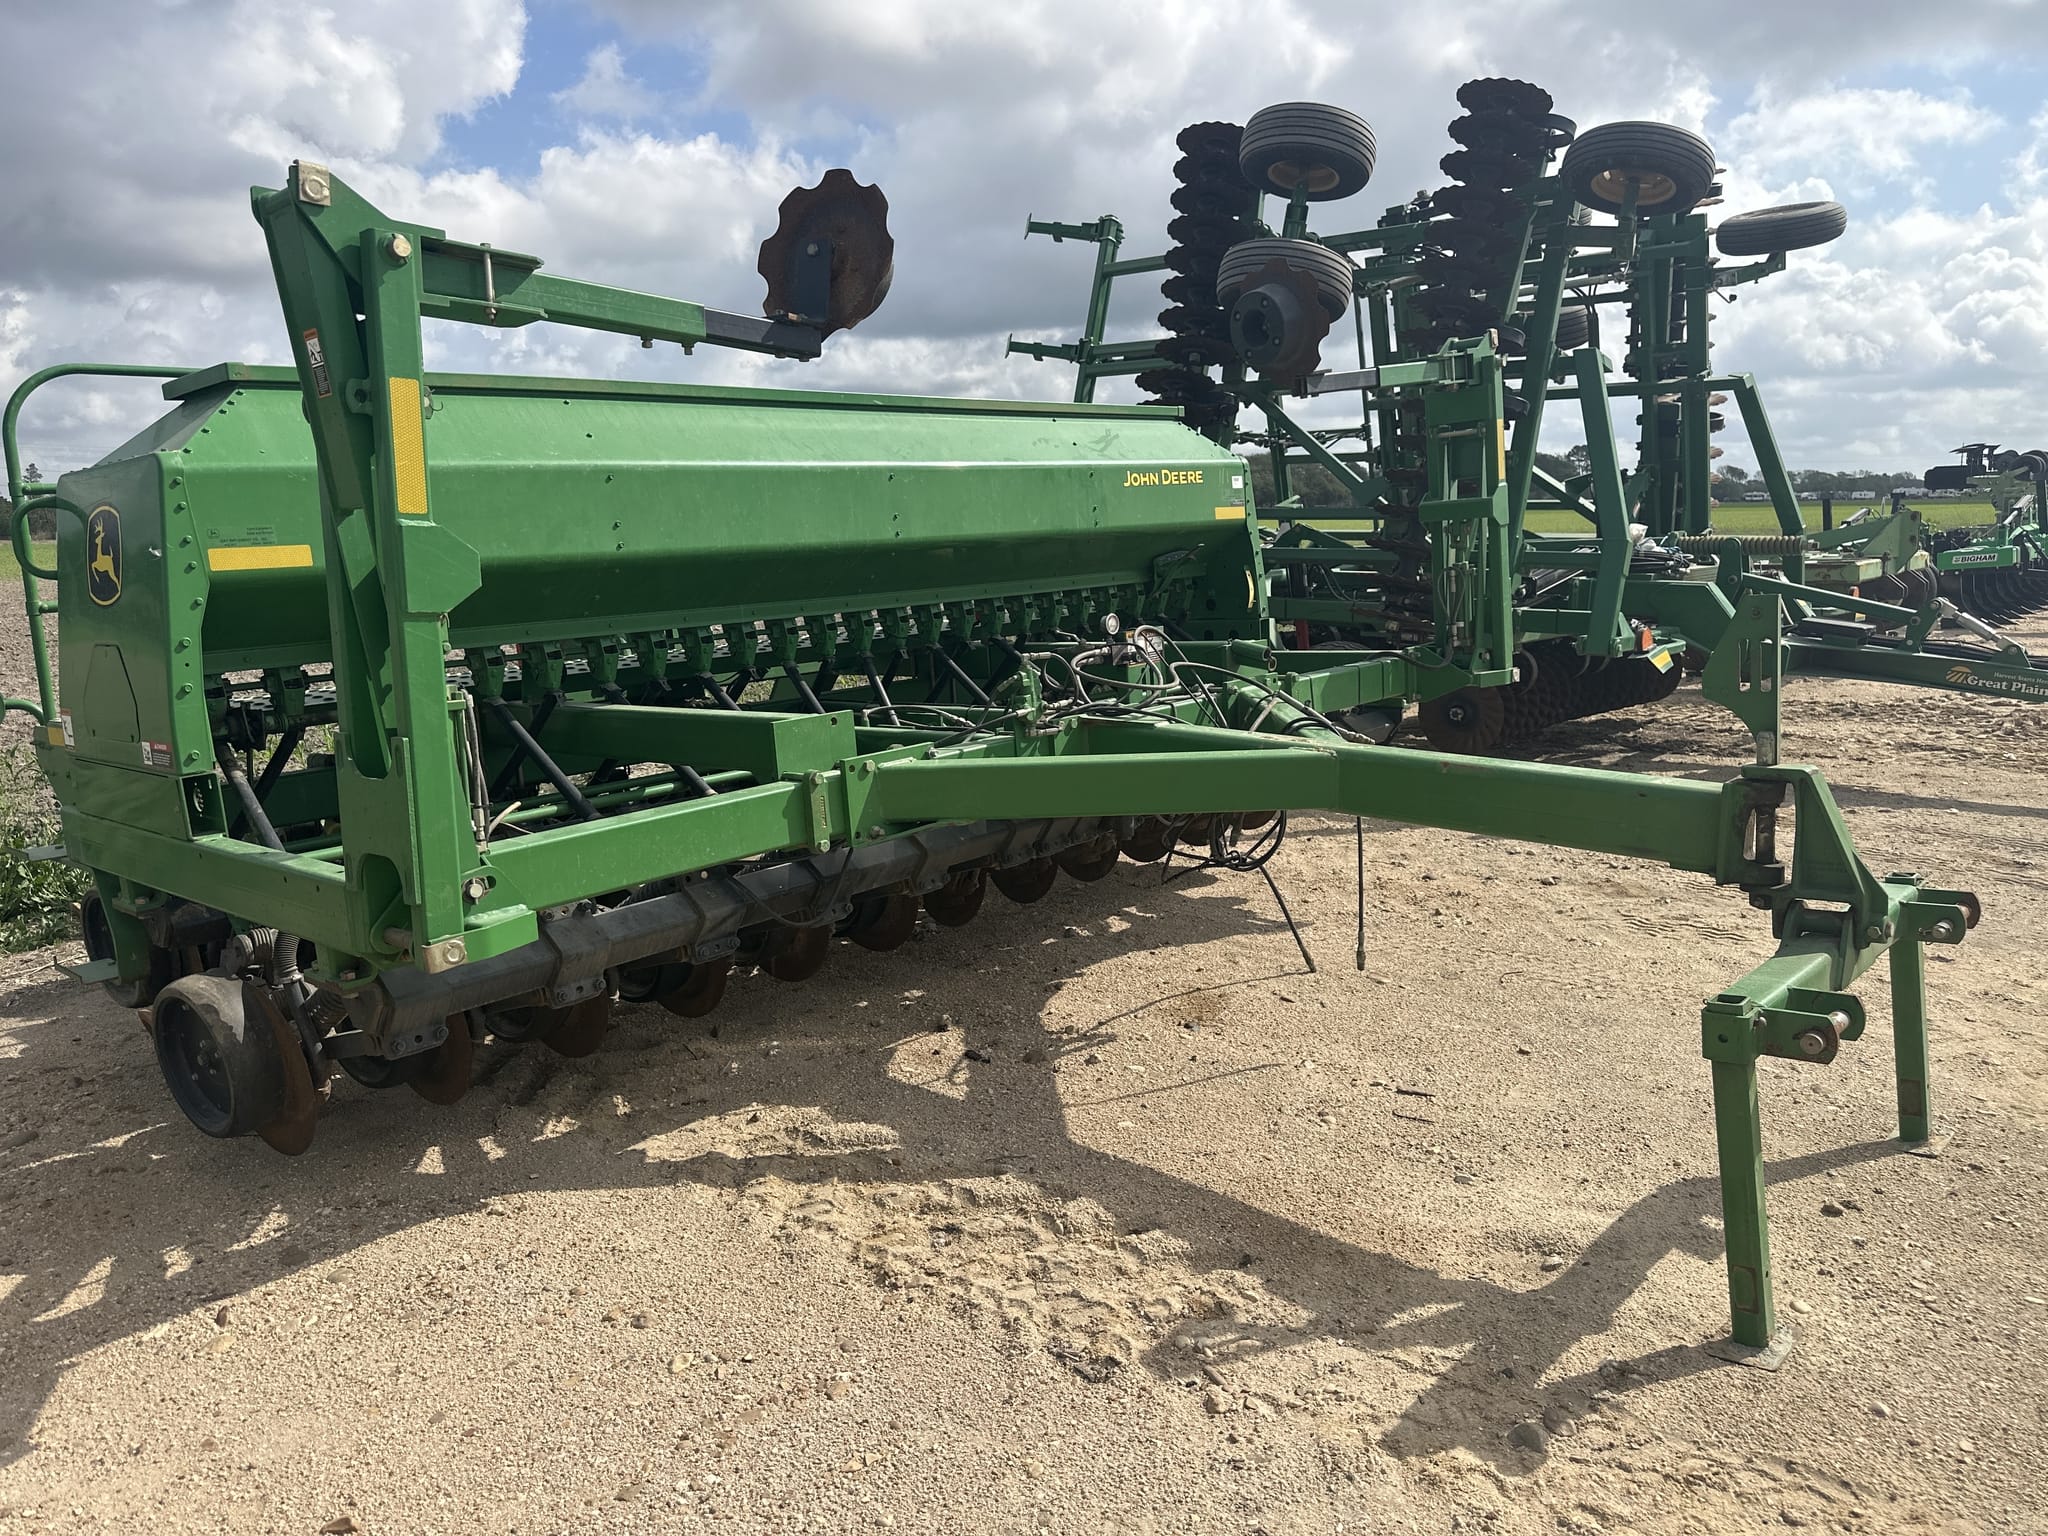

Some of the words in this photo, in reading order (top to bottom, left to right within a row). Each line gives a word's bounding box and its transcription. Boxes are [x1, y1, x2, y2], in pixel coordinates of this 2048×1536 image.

[1123, 470, 1159, 487] JOHN
[1161, 469, 1203, 485] DEERE
[1961, 554, 1996, 563] BIGHAM
[1967, 675, 2008, 690] Great
[2011, 681, 2048, 696] Plain
